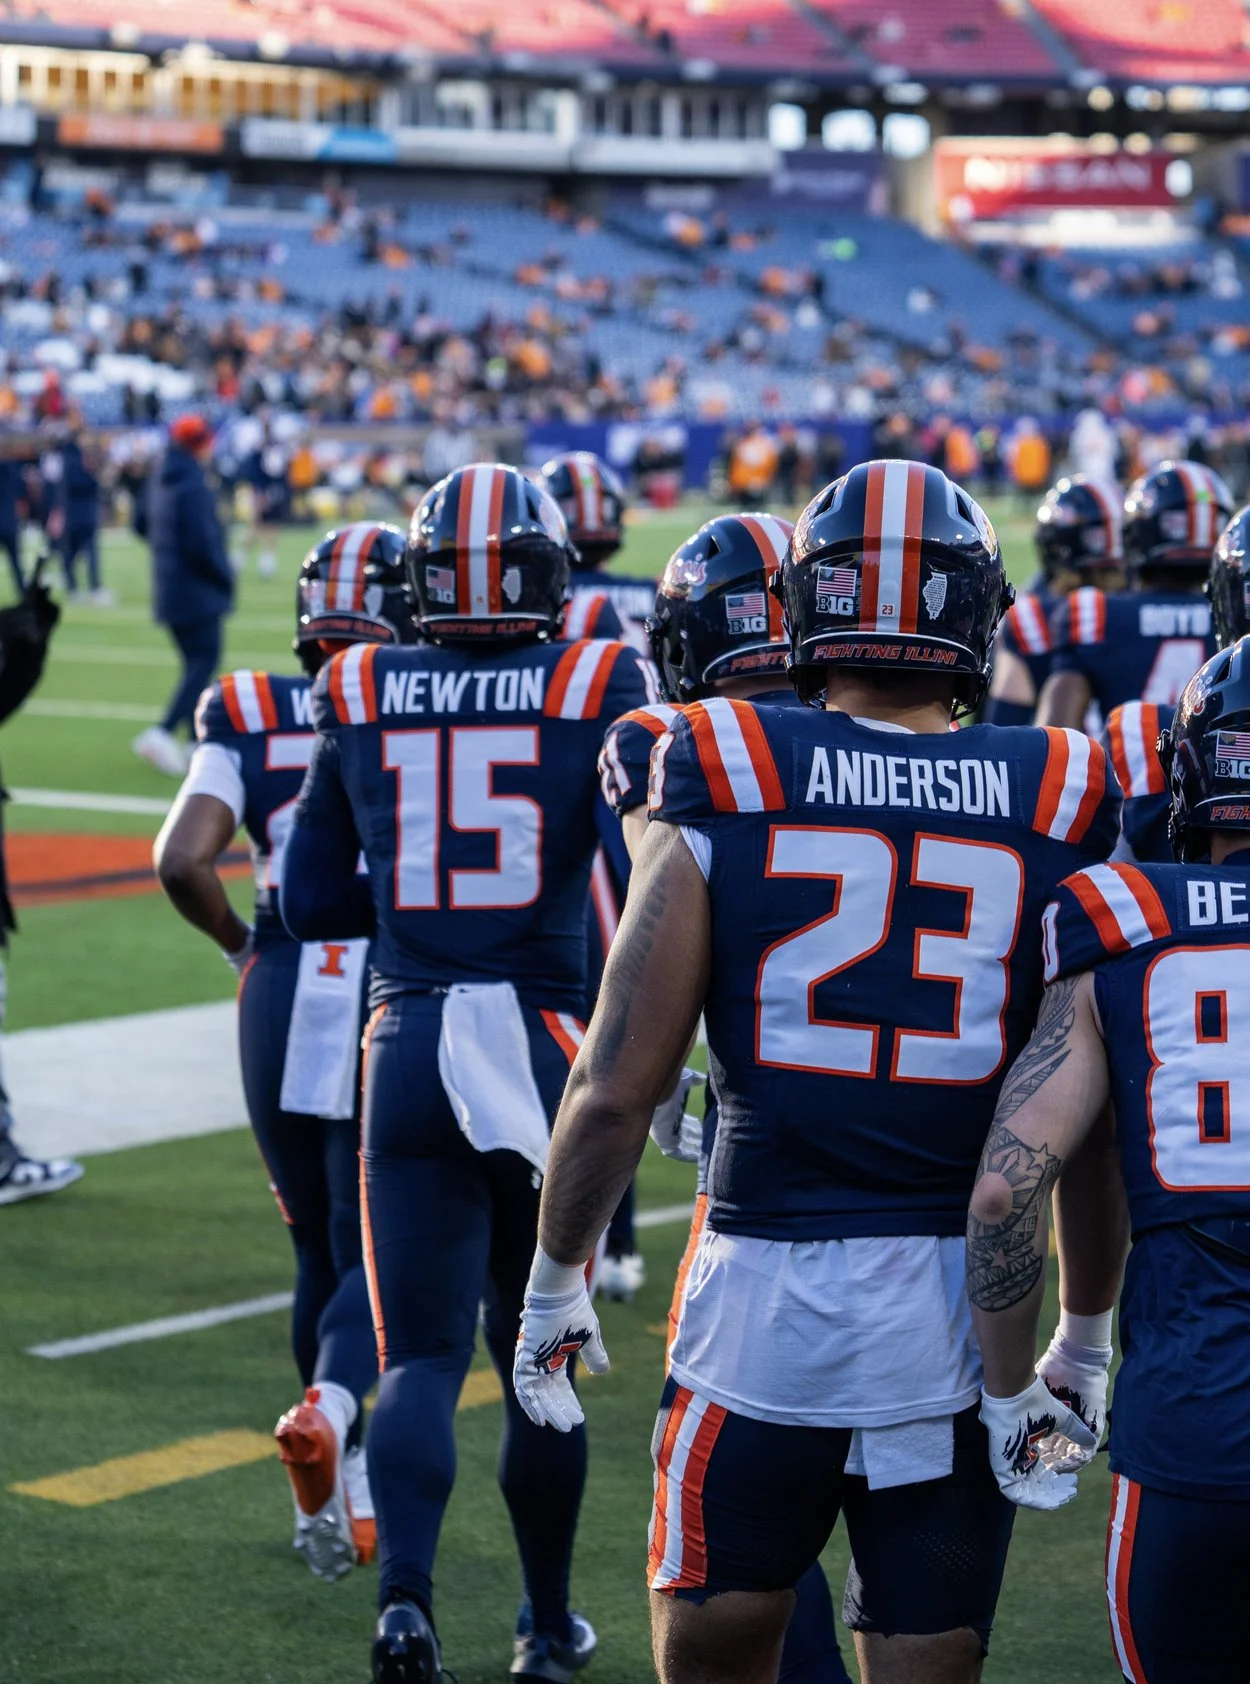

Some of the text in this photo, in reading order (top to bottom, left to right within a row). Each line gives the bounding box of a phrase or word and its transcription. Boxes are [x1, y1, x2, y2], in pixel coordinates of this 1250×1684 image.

[881, 605, 894, 615] 23
[813, 643, 959, 666] FIGHTING ILLINI
[382, 666, 545, 715] NEWTON
[805, 746, 1011, 818] ANDERSON
[382, 725, 545, 912] 15
[754, 824, 1025, 1086] 23
